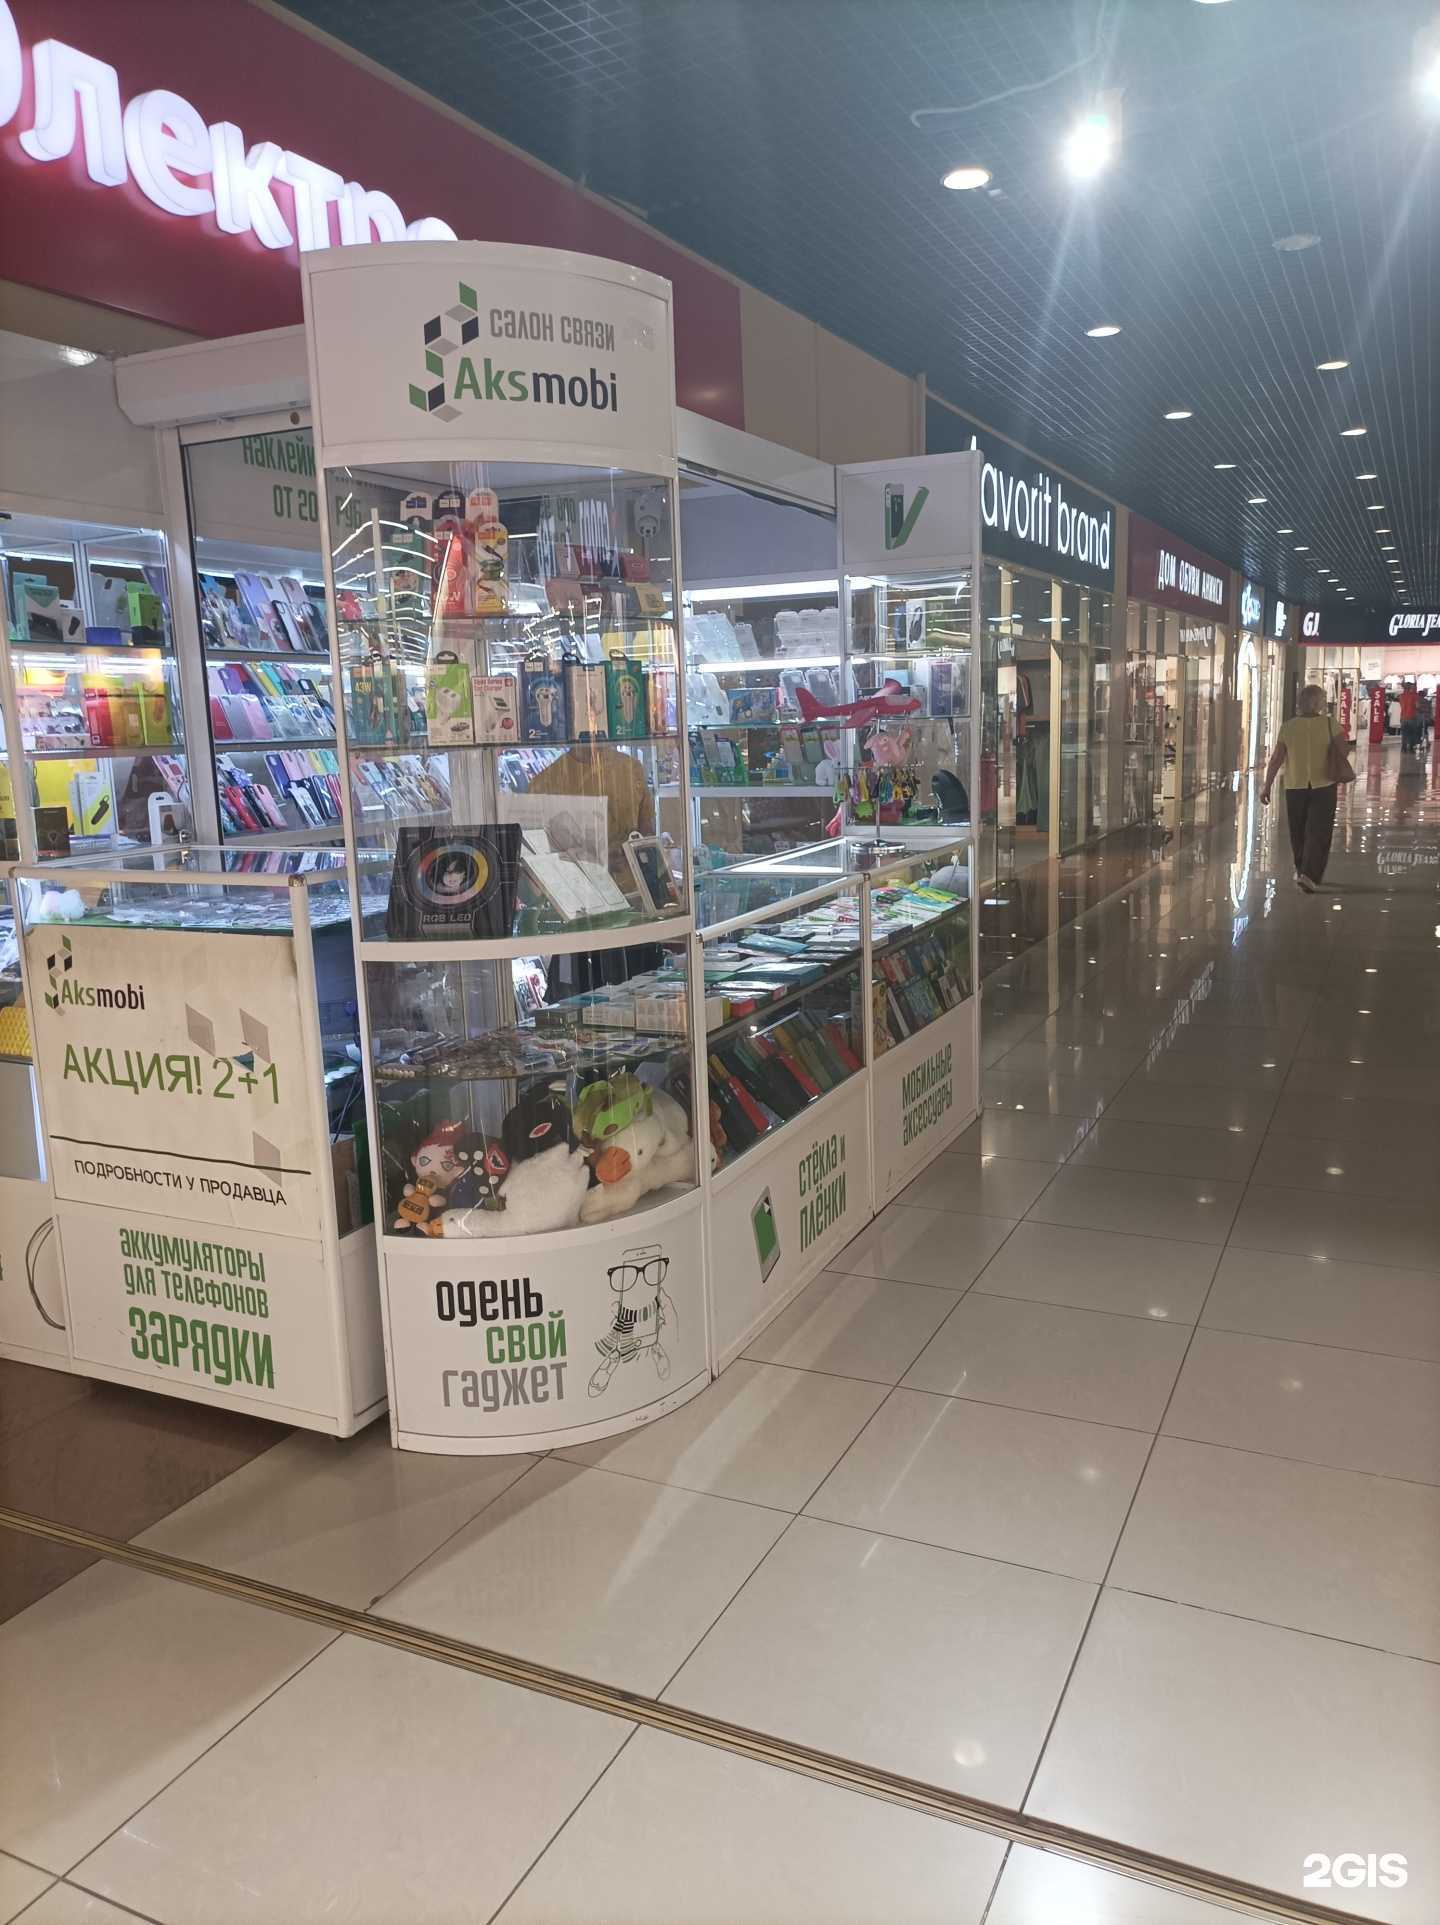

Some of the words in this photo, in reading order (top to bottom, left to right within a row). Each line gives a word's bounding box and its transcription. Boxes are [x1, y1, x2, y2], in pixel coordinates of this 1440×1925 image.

[0, 0, 459, 252] лектр
[453, 356, 619, 412] Aksmobi
[298, 489, 319, 522] 20
[970, 435, 1052, 547] avorit
[1057, 483, 1110, 570] brand
[1158, 549, 1177, 591] ДОМ
[1180, 559, 1200, 597] ОБУВИ
[1373, 690, 1382, 723] SALE
[423, 913, 446, 923] RGB
[450, 912, 473, 922] LED
[61, 979, 145, 1010] Aksmobi
[64, 1043, 203, 1096] АКЦИЯ!
[212, 1057, 279, 1105] 2+1
[75, 1159, 183, 1190] ПОДРОБНОСТИ
[185, 1175, 195, 1191] У
[200, 1177, 287, 1206] ПРОДАВЦА
